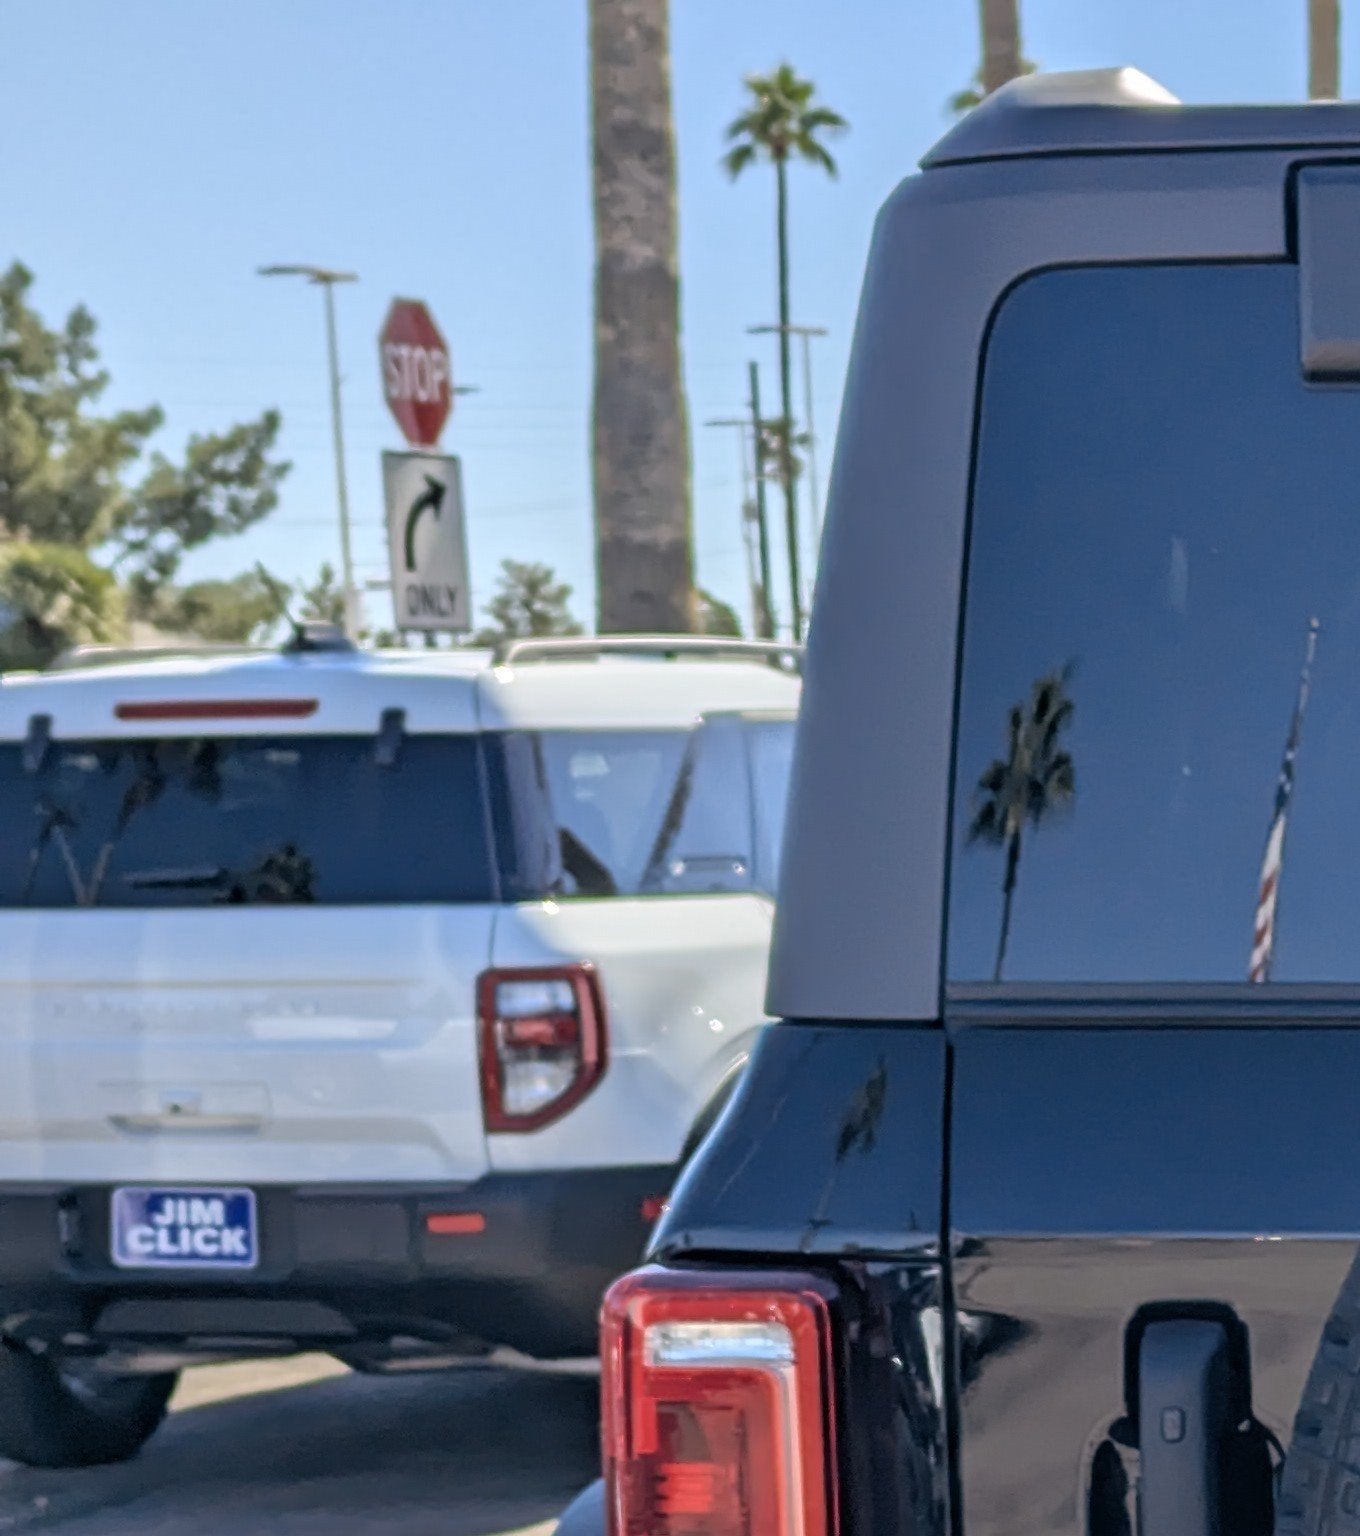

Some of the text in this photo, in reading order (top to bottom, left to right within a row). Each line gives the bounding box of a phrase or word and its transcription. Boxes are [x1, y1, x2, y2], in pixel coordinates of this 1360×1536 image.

[383, 343, 447, 403] STOP
[405, 583, 457, 618] ONLY
[153, 1198, 225, 1225] JIM
[126, 1225, 248, 1256] CLICK
